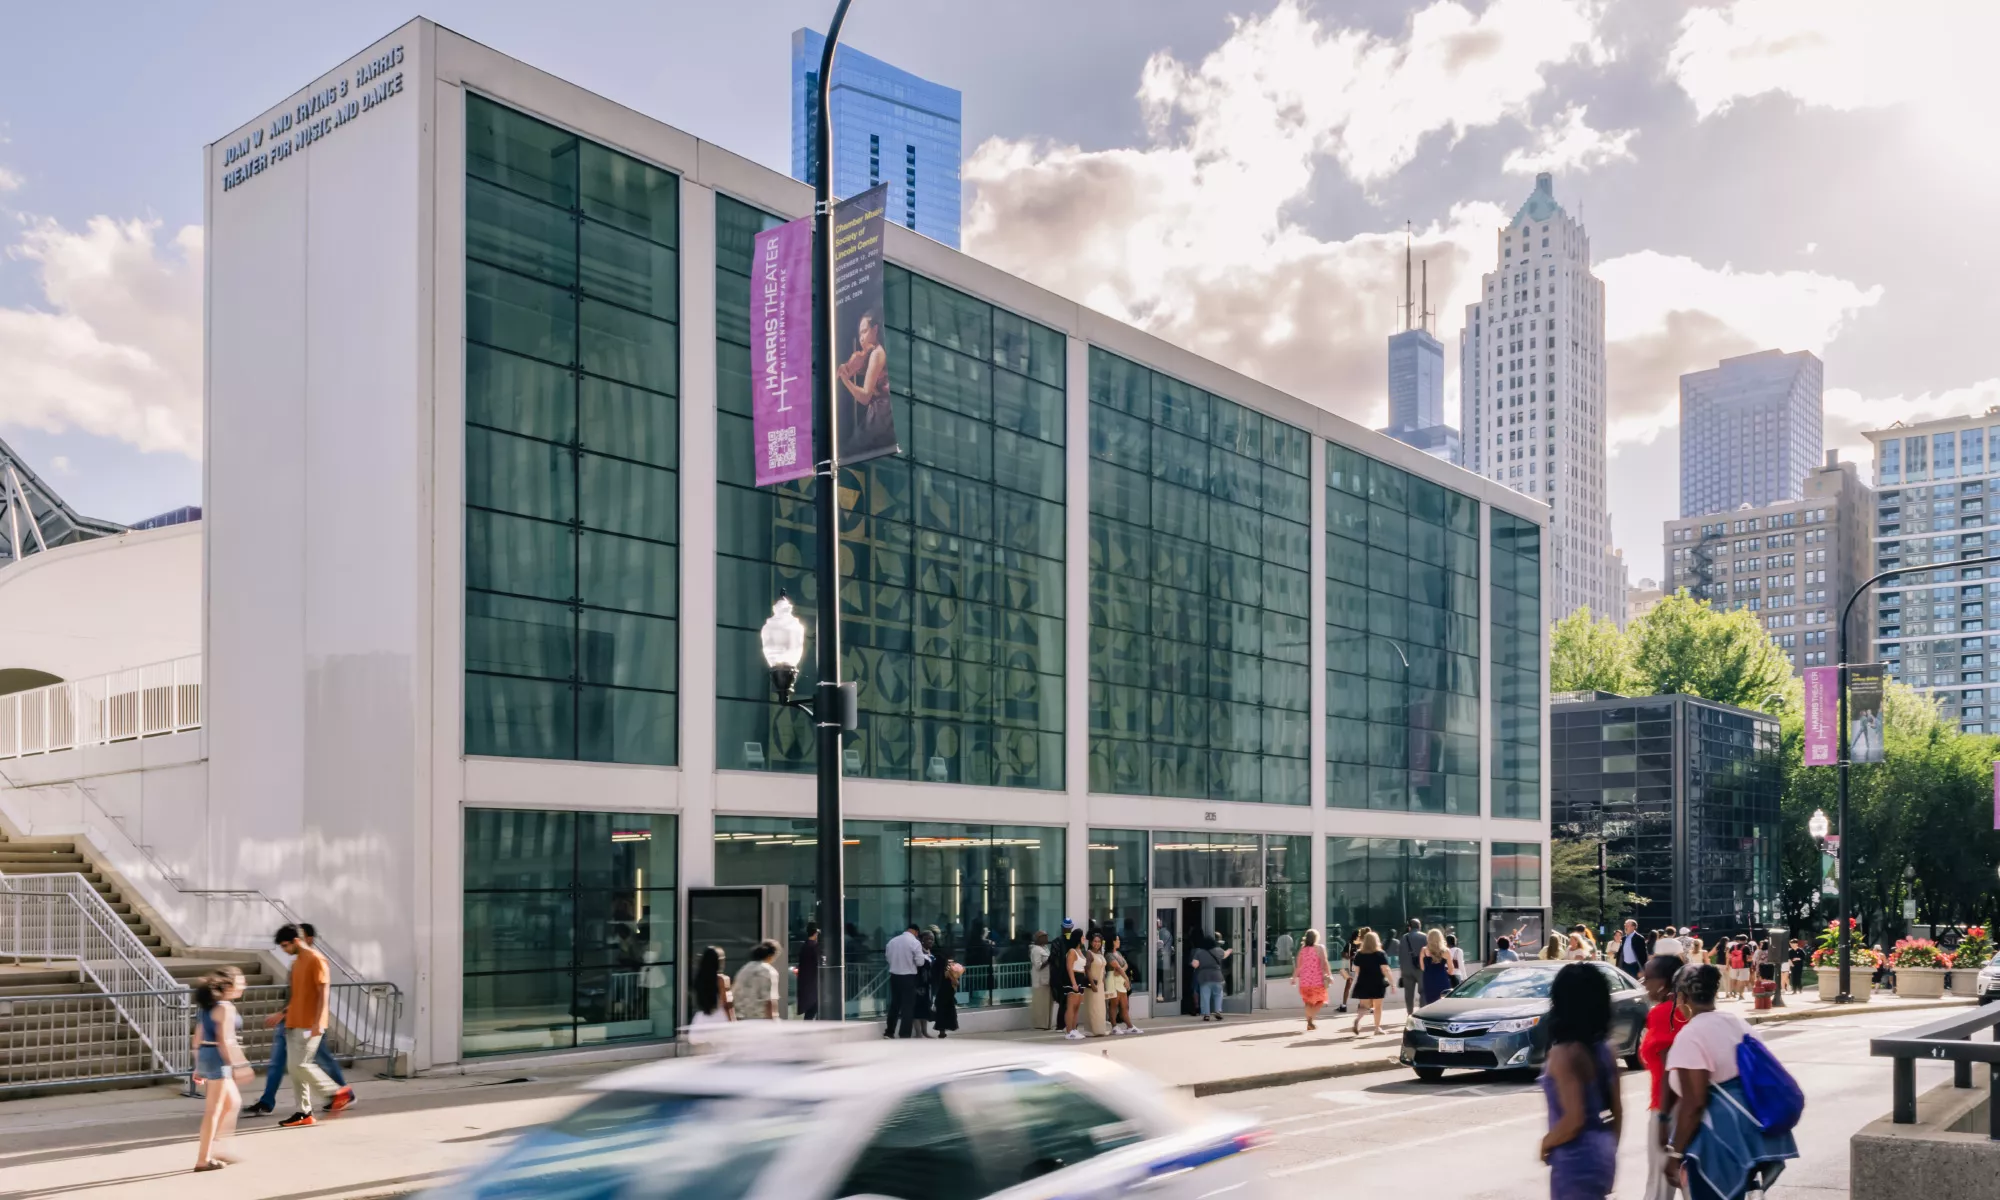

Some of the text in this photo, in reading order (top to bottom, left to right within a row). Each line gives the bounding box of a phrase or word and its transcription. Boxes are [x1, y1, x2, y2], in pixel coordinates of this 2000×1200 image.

[223, 136, 250, 167] JOAN
[252, 127, 265, 149] W
[269, 112, 292, 139] AND
[295, 85, 337, 125] IRVING
[355, 45, 404, 88] HARRIS
[221, 72, 404, 192] THEATER FOR MUSIC AND DANCE
[835, 207, 884, 234] Chamber Music
[835, 227, 866, 247] Society of
[835, 235, 879, 260] Lincoln Center
[765, 236, 780, 390] HARRIS THEATER
[779, 300, 788, 369] MILLENNIUM
[1204, 812, 1217, 821] 205
